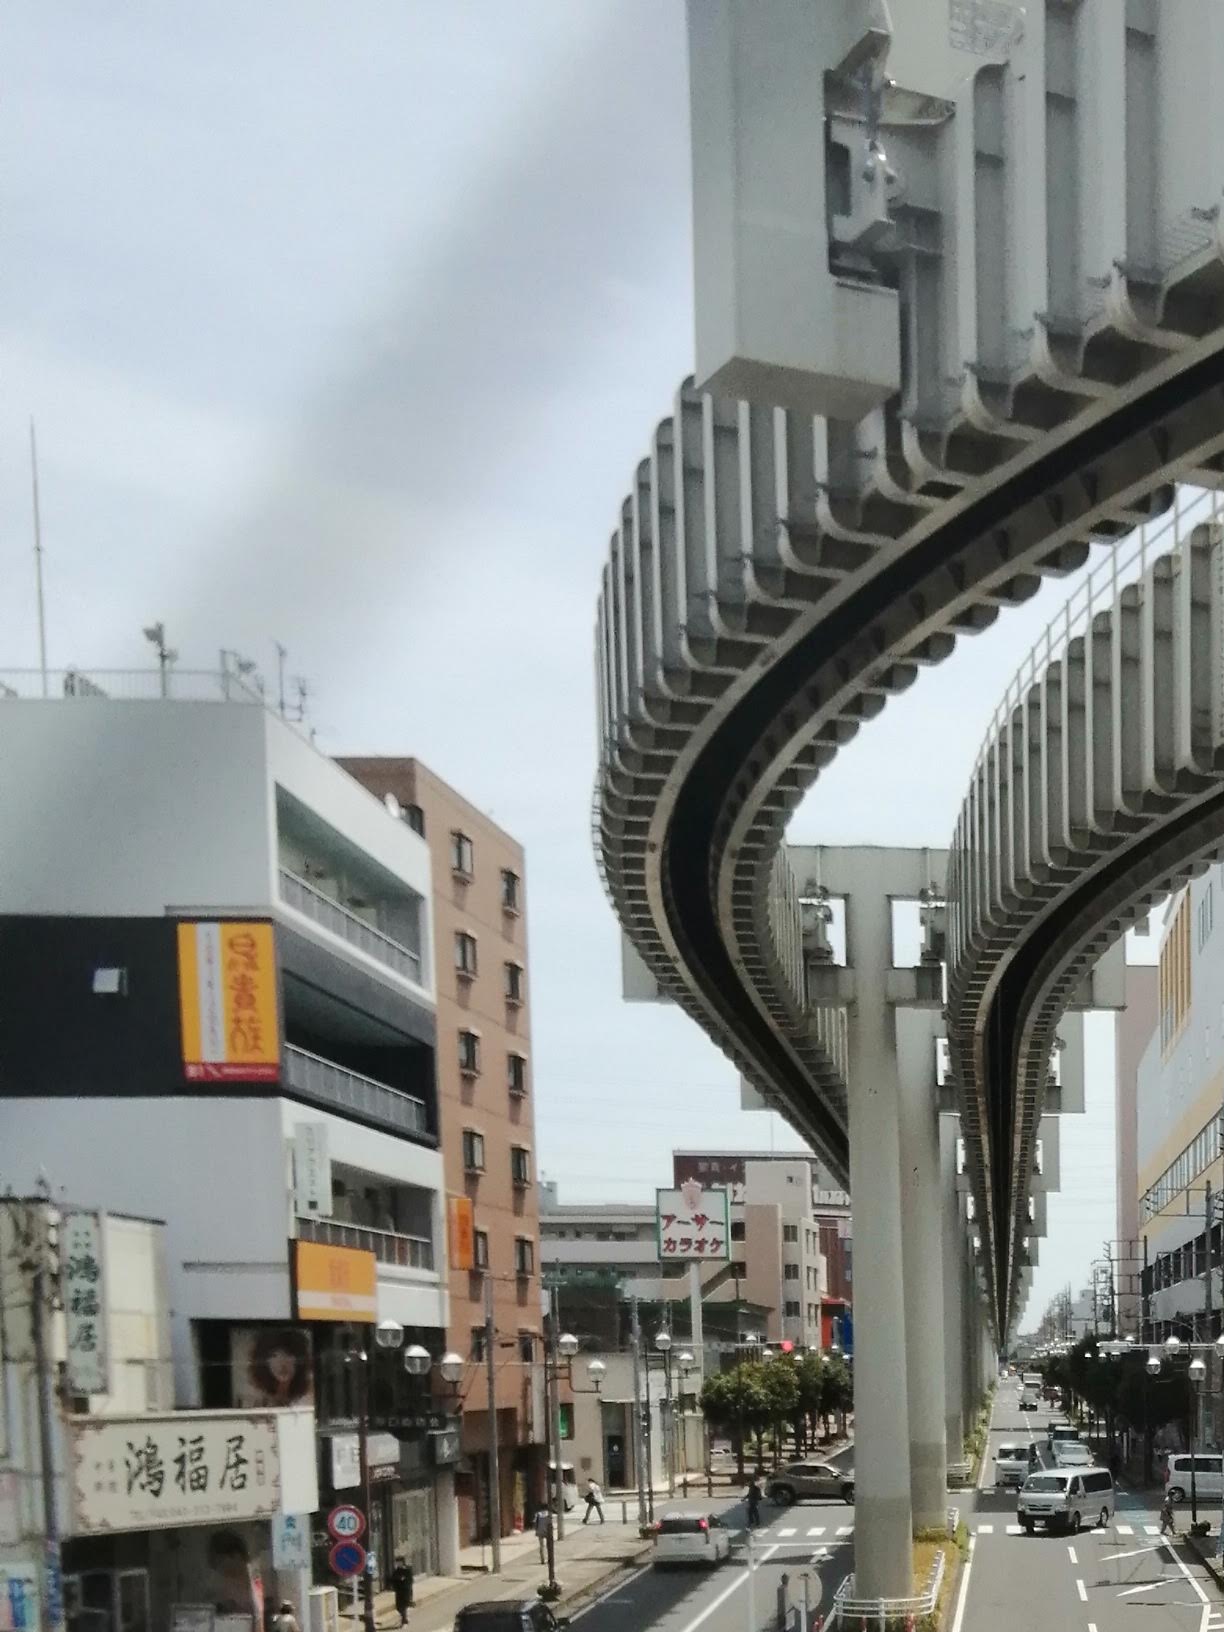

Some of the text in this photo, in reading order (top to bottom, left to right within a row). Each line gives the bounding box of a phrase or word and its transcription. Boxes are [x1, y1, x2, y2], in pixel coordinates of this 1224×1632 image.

[660, 1213, 725, 1231] アーサー
[663, 1237, 724, 1254] カラオケ
[337, 1515, 357, 1531] 40
